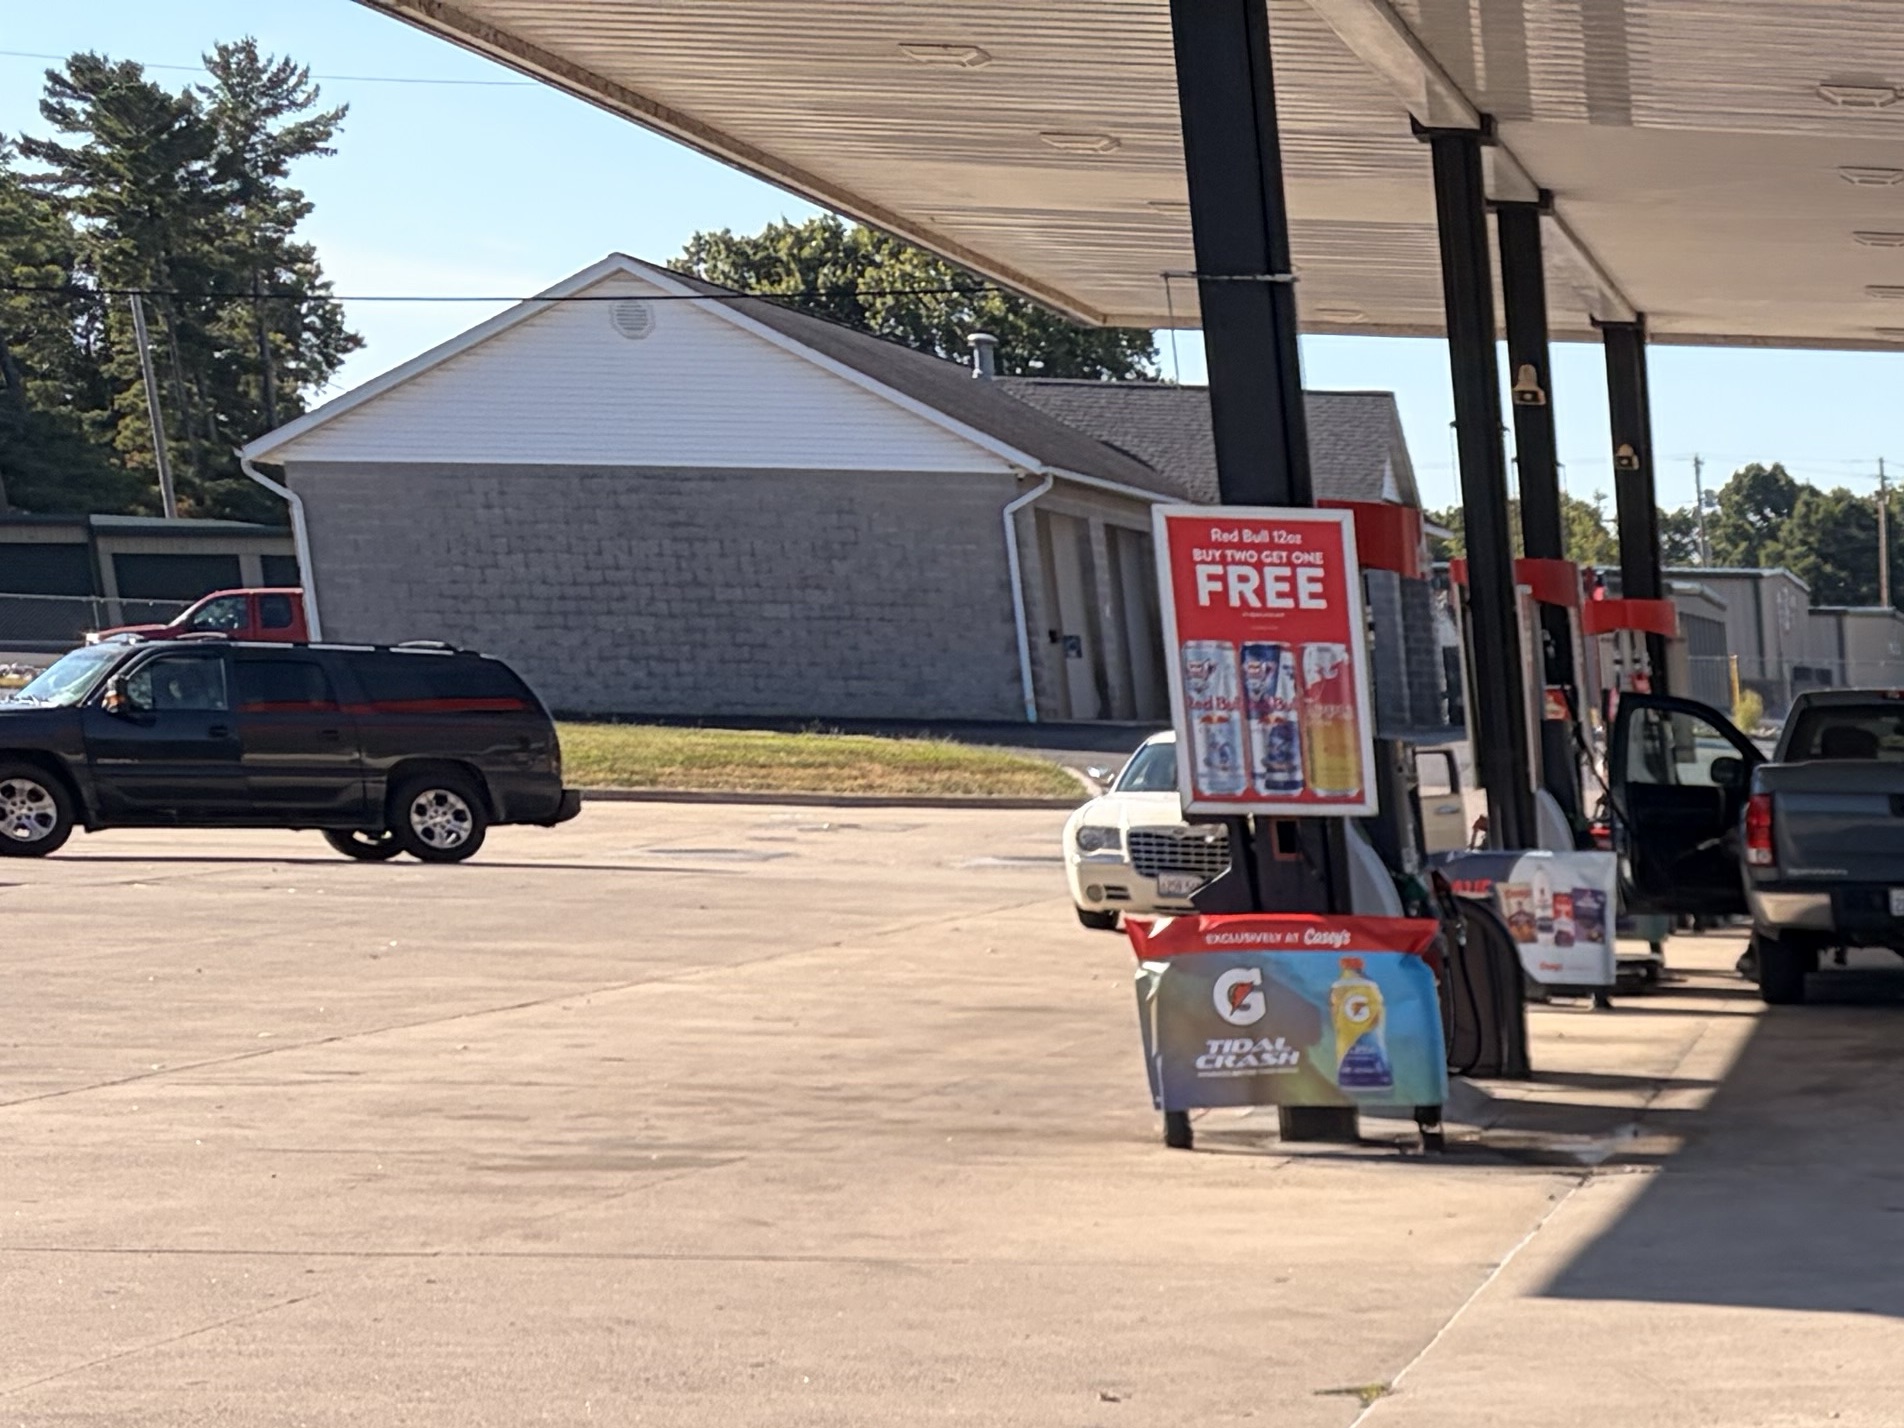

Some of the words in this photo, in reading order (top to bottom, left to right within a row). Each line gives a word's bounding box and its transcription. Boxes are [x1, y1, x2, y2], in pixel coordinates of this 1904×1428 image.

[1210, 527, 1239, 543] Red
[1242, 528, 1270, 543] Bull
[1272, 529, 1302, 545] 12oz
[1192, 547, 1221, 562] BUY
[1225, 549, 1258, 563] TWO
[1260, 550, 1288, 564] GET
[1291, 551, 1324, 565] ONE
[1195, 563, 1328, 610] FREE
[1205, 932, 1282, 945] EXCLUSIVELY
[1284, 931, 1300, 944] AT
[1303, 927, 1351, 949] Casey's
[1213, 966, 1267, 1027] G
[1205, 1035, 1291, 1055] TIDAL
[1194, 1050, 1301, 1070] CRASH
